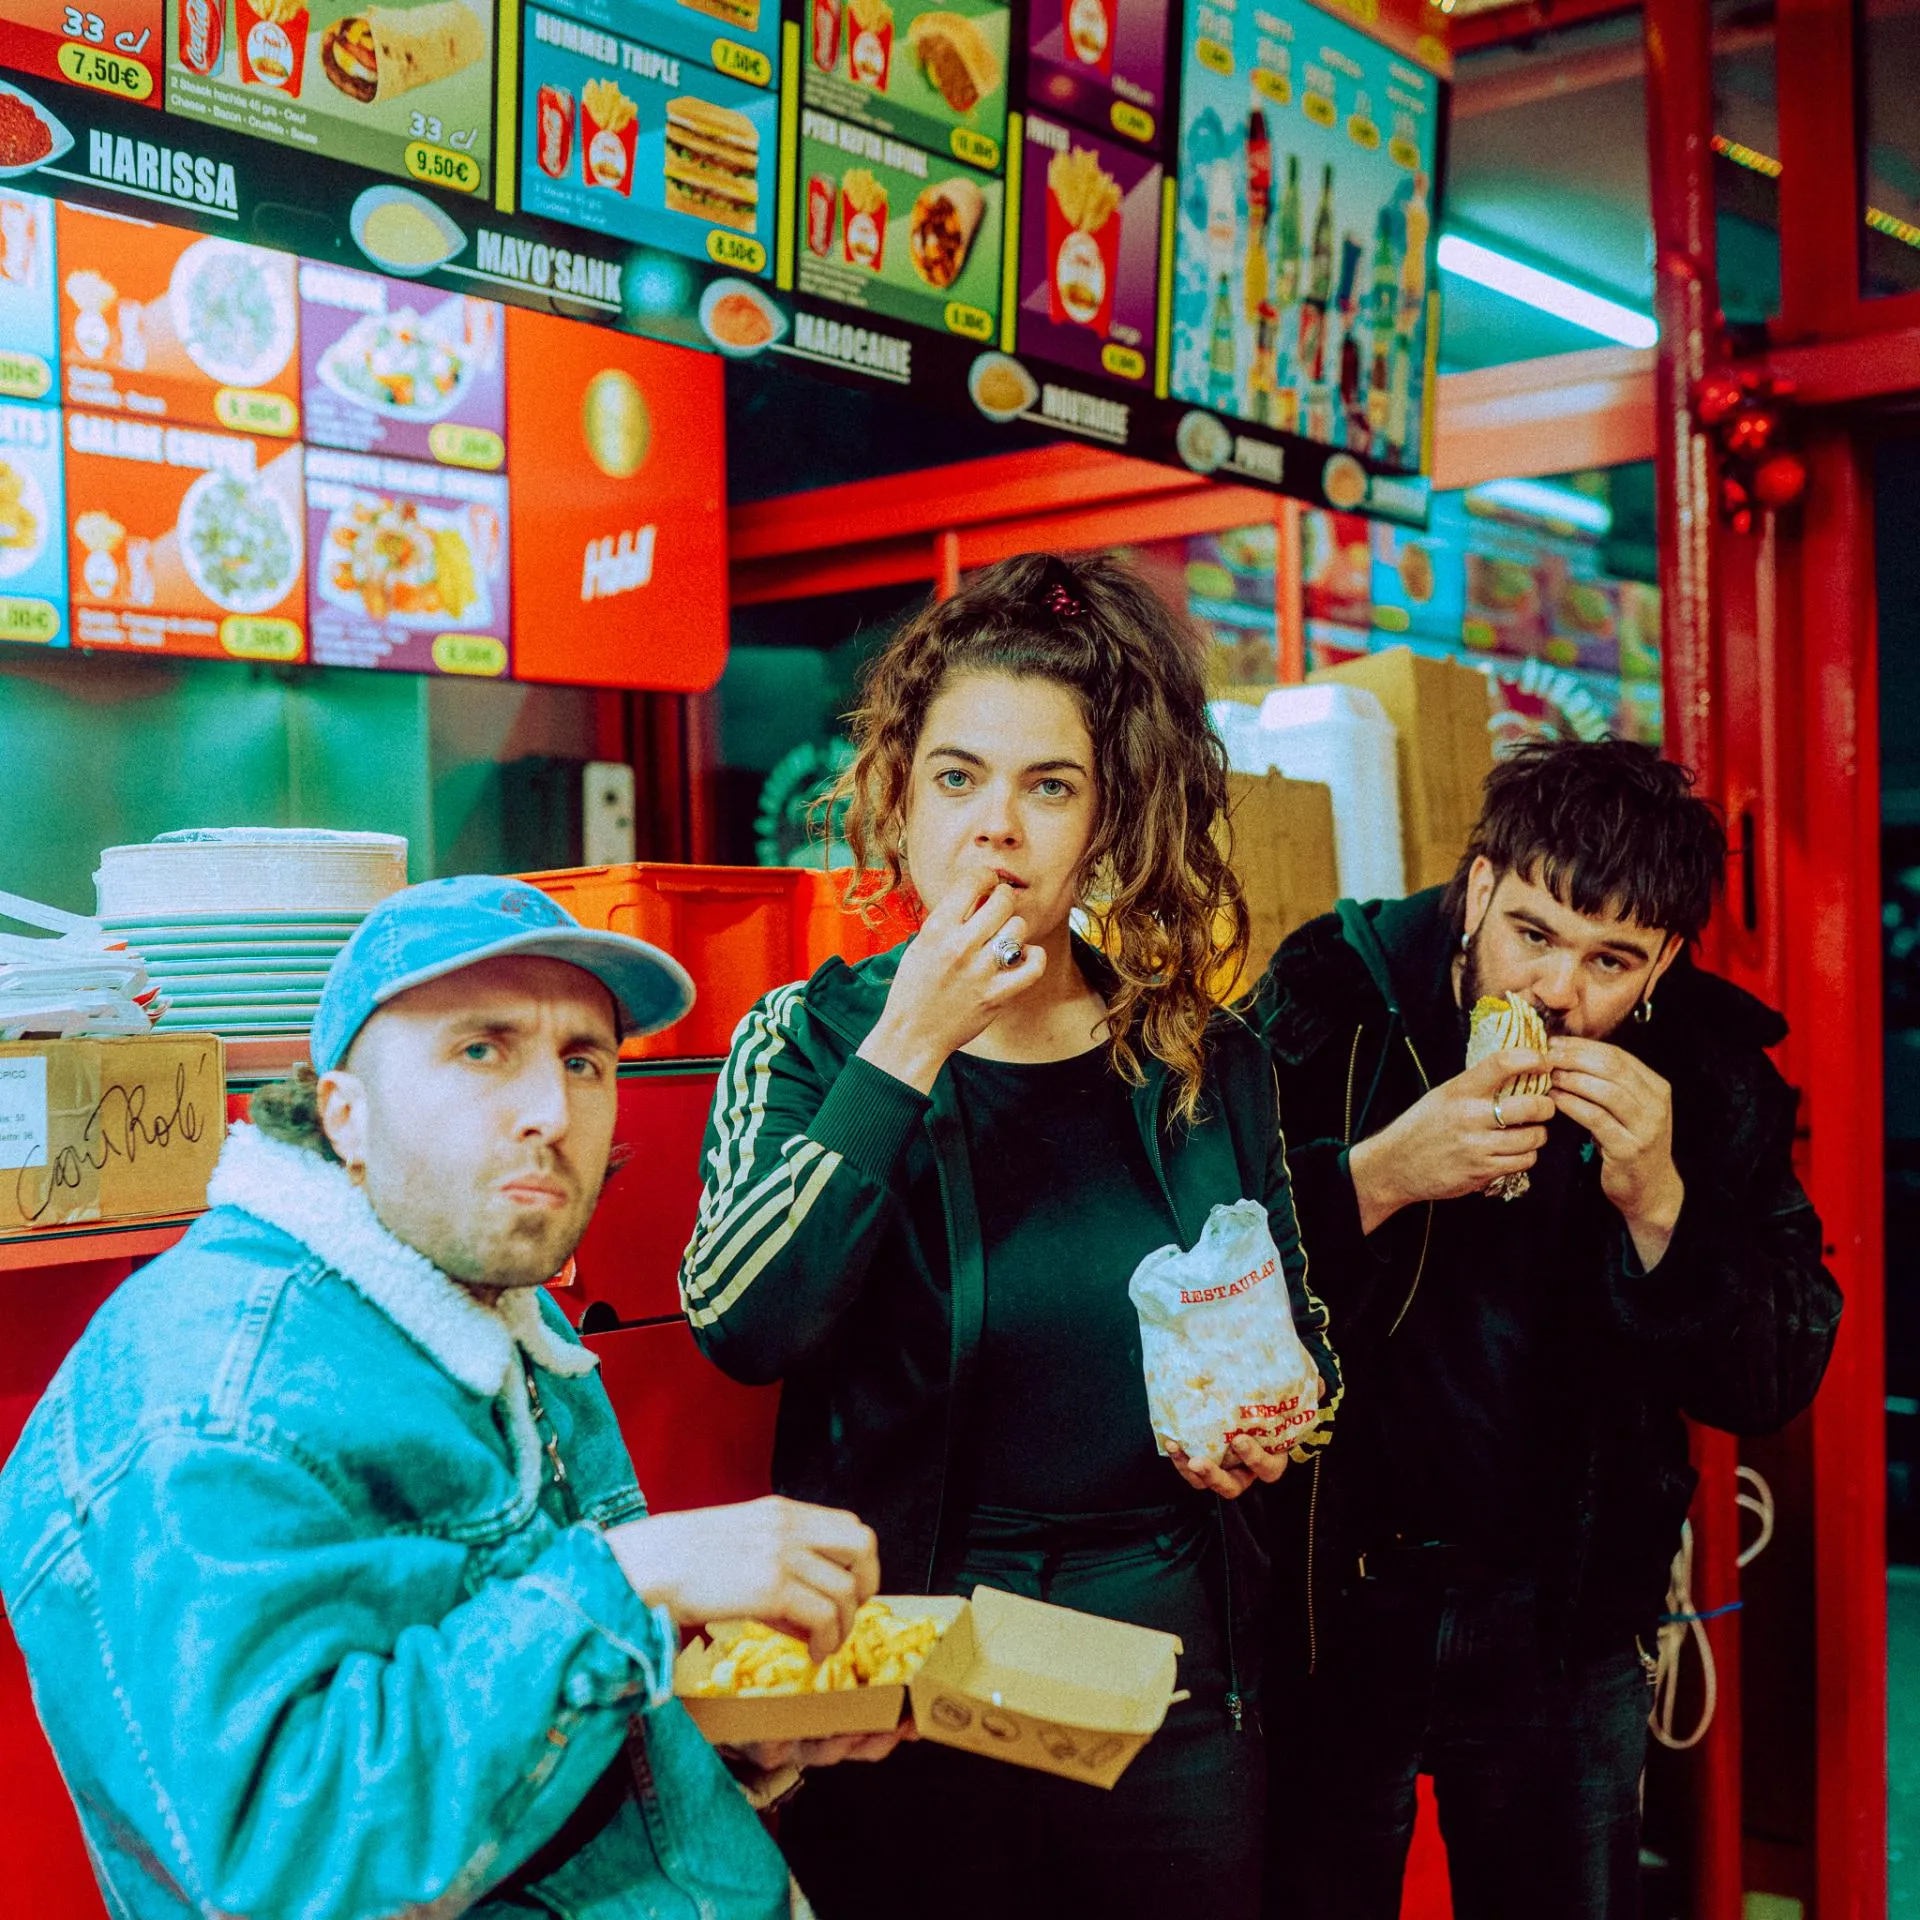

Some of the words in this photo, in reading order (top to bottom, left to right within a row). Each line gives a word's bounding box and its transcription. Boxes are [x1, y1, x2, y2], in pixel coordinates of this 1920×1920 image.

[62, 6, 105, 43] 33
[72, 50, 140, 91] 7,50€
[408, 109, 443, 143] 33
[89, 128, 239, 212] HARISSA
[416, 149, 469, 183] 9,50€
[1180, 1256, 1277, 1304] RESTAURAN
